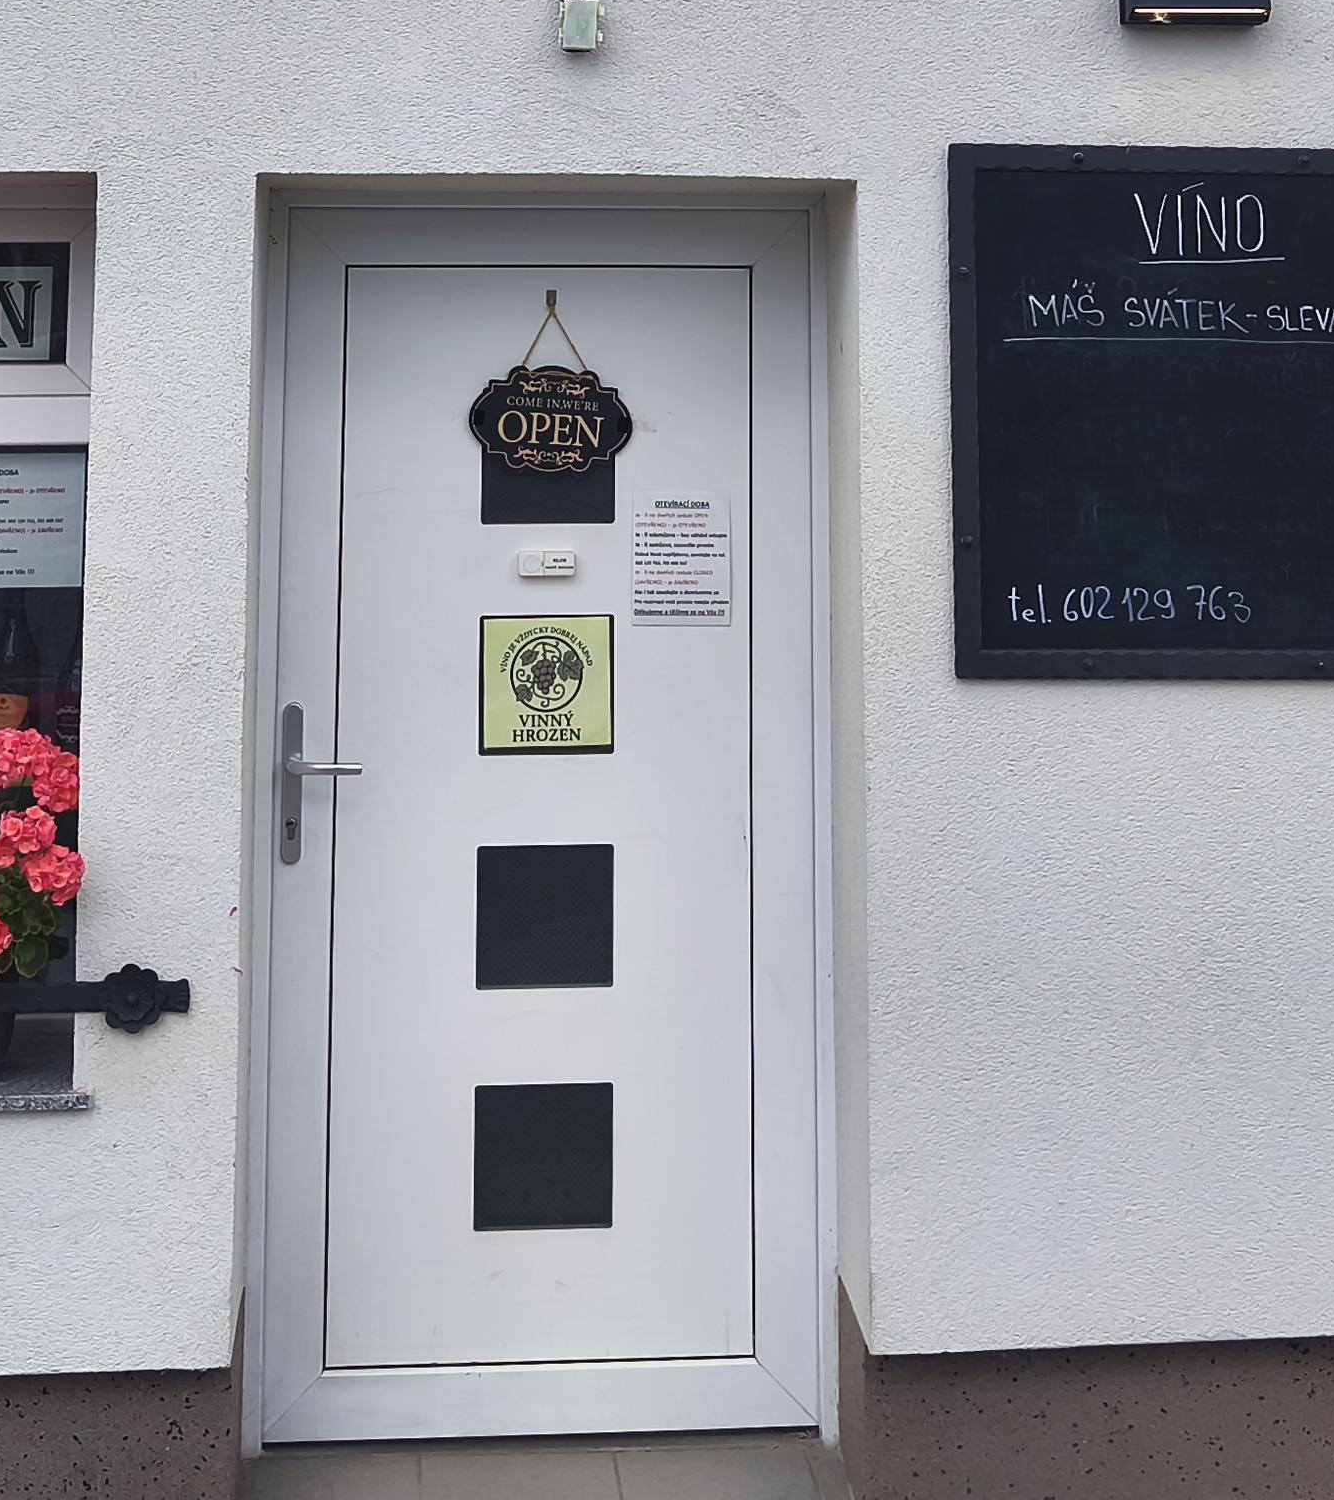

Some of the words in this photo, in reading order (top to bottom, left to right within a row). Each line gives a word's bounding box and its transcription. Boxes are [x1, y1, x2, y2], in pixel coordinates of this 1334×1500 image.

[1134, 182, 1265, 256] VÍNO
[1028, 278, 1105, 328] MÁŠ
[507, 395, 543, 408] COME
[498, 410, 605, 448] OPEN
[1007, 583, 1052, 624] tel.
[1063, 585, 1115, 622] 602
[1121, 586, 1176, 622] 129
[1186, 584, 1251, 623] 763
[508, 642, 517, 654] JE
[514, 626, 549, 645] VŽDYCKY
[512, 728, 582, 742] HROZEN
[518, 710, 574, 728] VINNÝ
